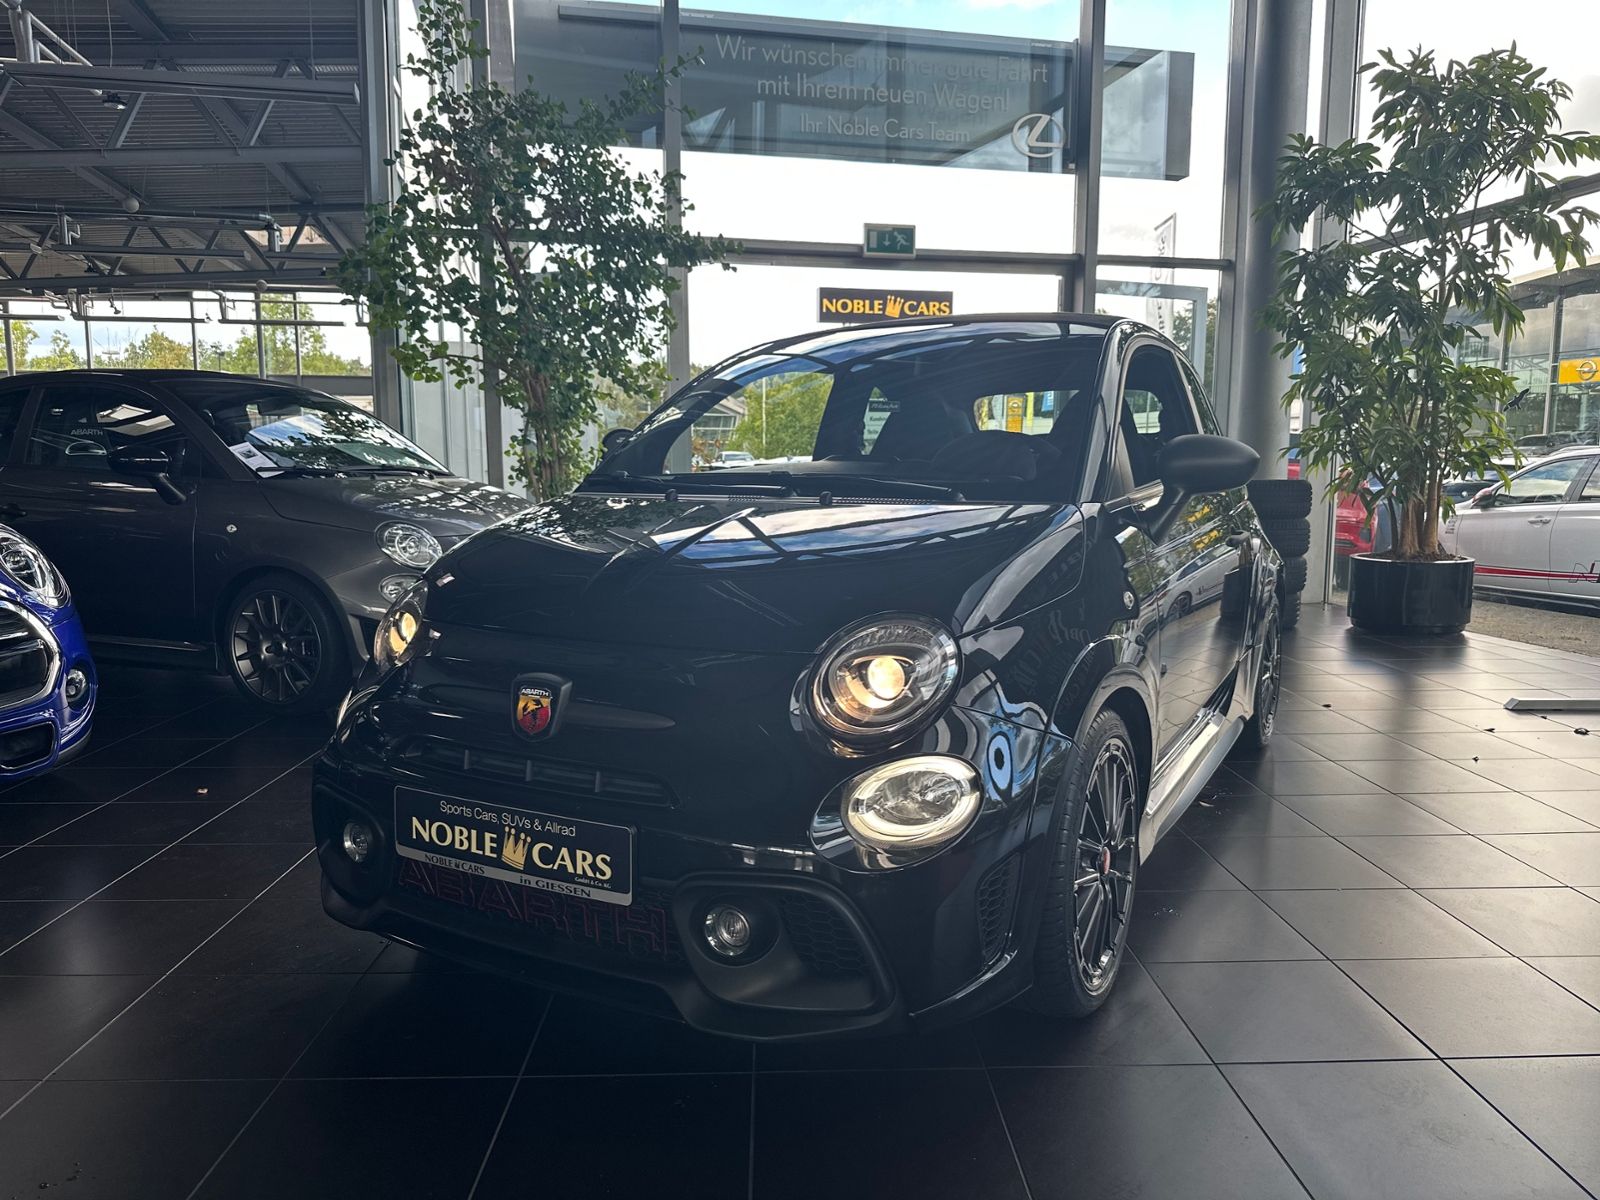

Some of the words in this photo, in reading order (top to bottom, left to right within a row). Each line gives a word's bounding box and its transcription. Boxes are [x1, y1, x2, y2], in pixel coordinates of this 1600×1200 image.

[715, 34, 756, 60] Wir
[762, 43, 868, 68] wünschen
[945, 60, 990, 81] gute
[996, 56, 1048, 83] Fahrt
[757, 75, 790, 96] mit
[797, 73, 857, 100] Ihrem
[864, 86, 928, 105] neuen
[934, 82, 1010, 114] Wagen!
[801, 112, 823, 133] Ihr
[827, 115, 880, 137] Noble
[884, 118, 924, 139] Cars
[927, 121, 971, 142] Team
[822, 298, 884, 315] NOBLE
[903, 301, 951, 316] CARS
[70, 428, 104, 436] ABARTH
[521, 688, 549, 697] ABARTH
[440, 800, 472, 817] Sports
[474, 807, 500, 824] Cars,
[501, 812, 532, 829] SUVs
[533, 818, 543, 831] &
[544, 820, 577, 837] Allrad
[411, 816, 498, 858] NOBLE
[531, 842, 613, 881] CARS
[424, 854, 454, 868] NOBLE
[461, 862, 486, 875] CARS
[520, 875, 531, 886] in
[535, 879, 592, 898] GIESSEN
